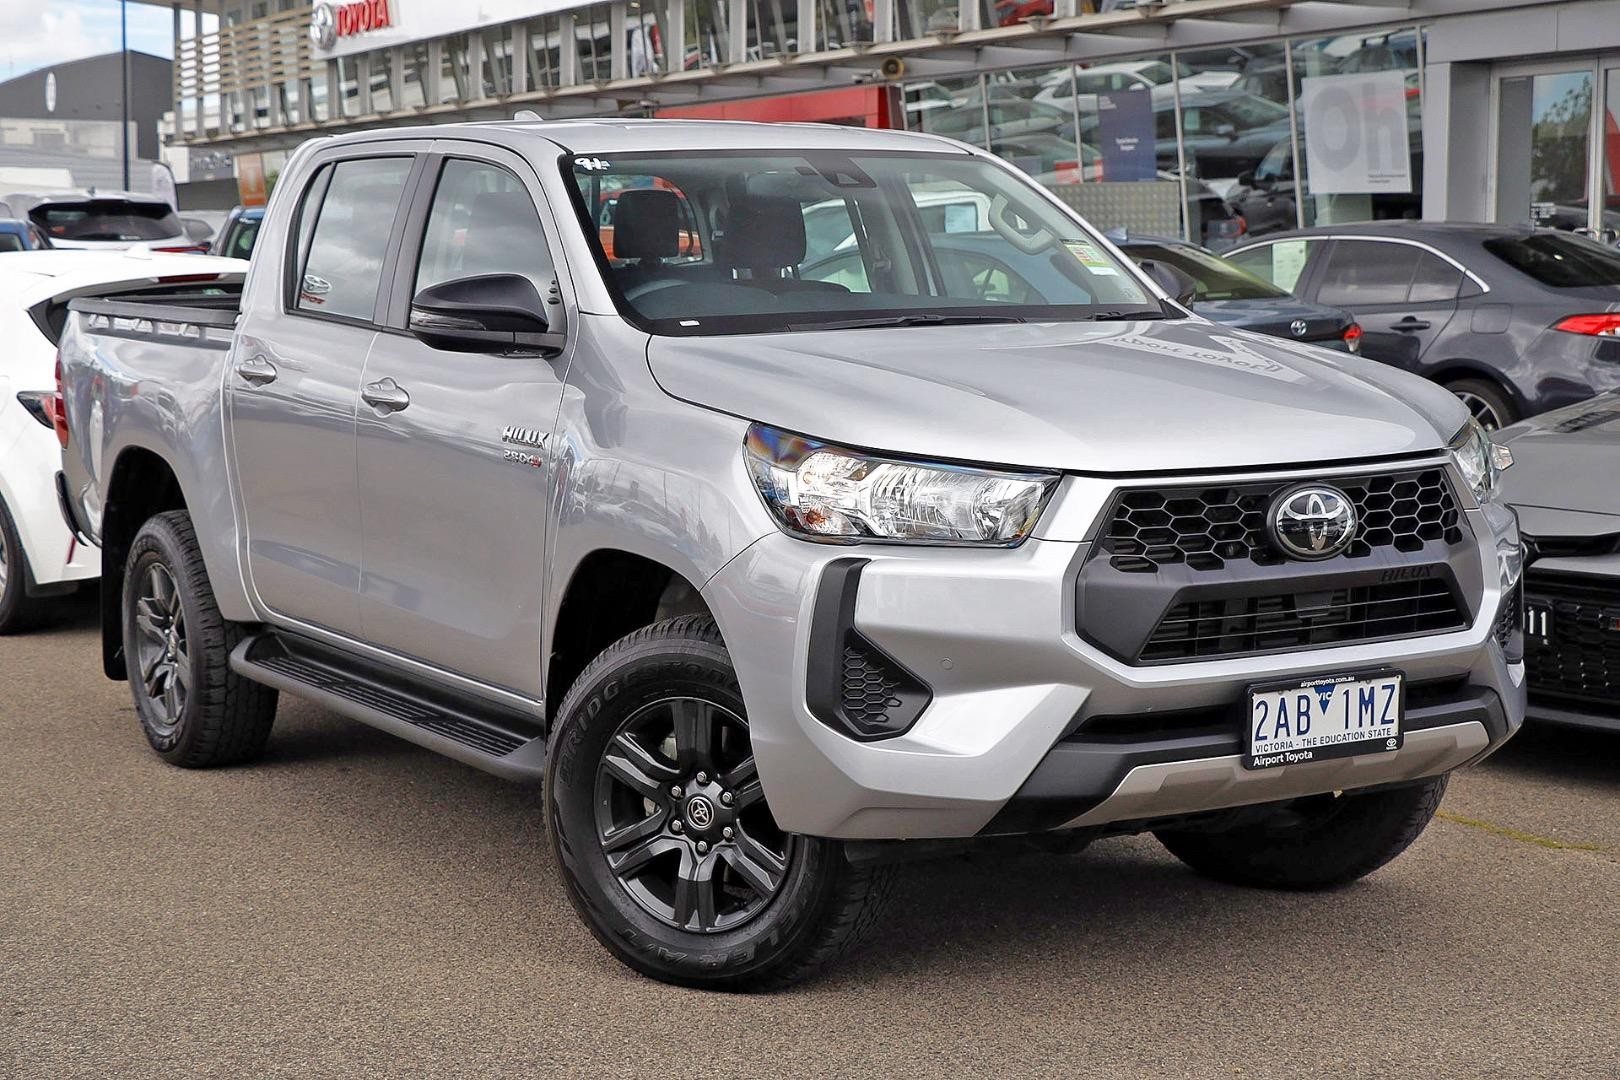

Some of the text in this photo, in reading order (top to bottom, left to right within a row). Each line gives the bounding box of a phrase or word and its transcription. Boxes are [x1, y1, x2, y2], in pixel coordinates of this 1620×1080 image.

[335, 0, 389, 37] TOYOTA
[502, 425, 550, 450] HILUX
[1300, 675, 1355, 688] airporttoyota.com.au
[1316, 690, 1333, 702] VIC
[1255, 683, 1396, 742] 2AB 1MZ
[1255, 741, 1294, 753] VICTORIA
[1301, 738, 1317, 748] THE
[1319, 731, 1366, 746] EDUCATION
[1367, 727, 1392, 739] STATE
[1253, 750, 1313, 767] Airport Toyota
